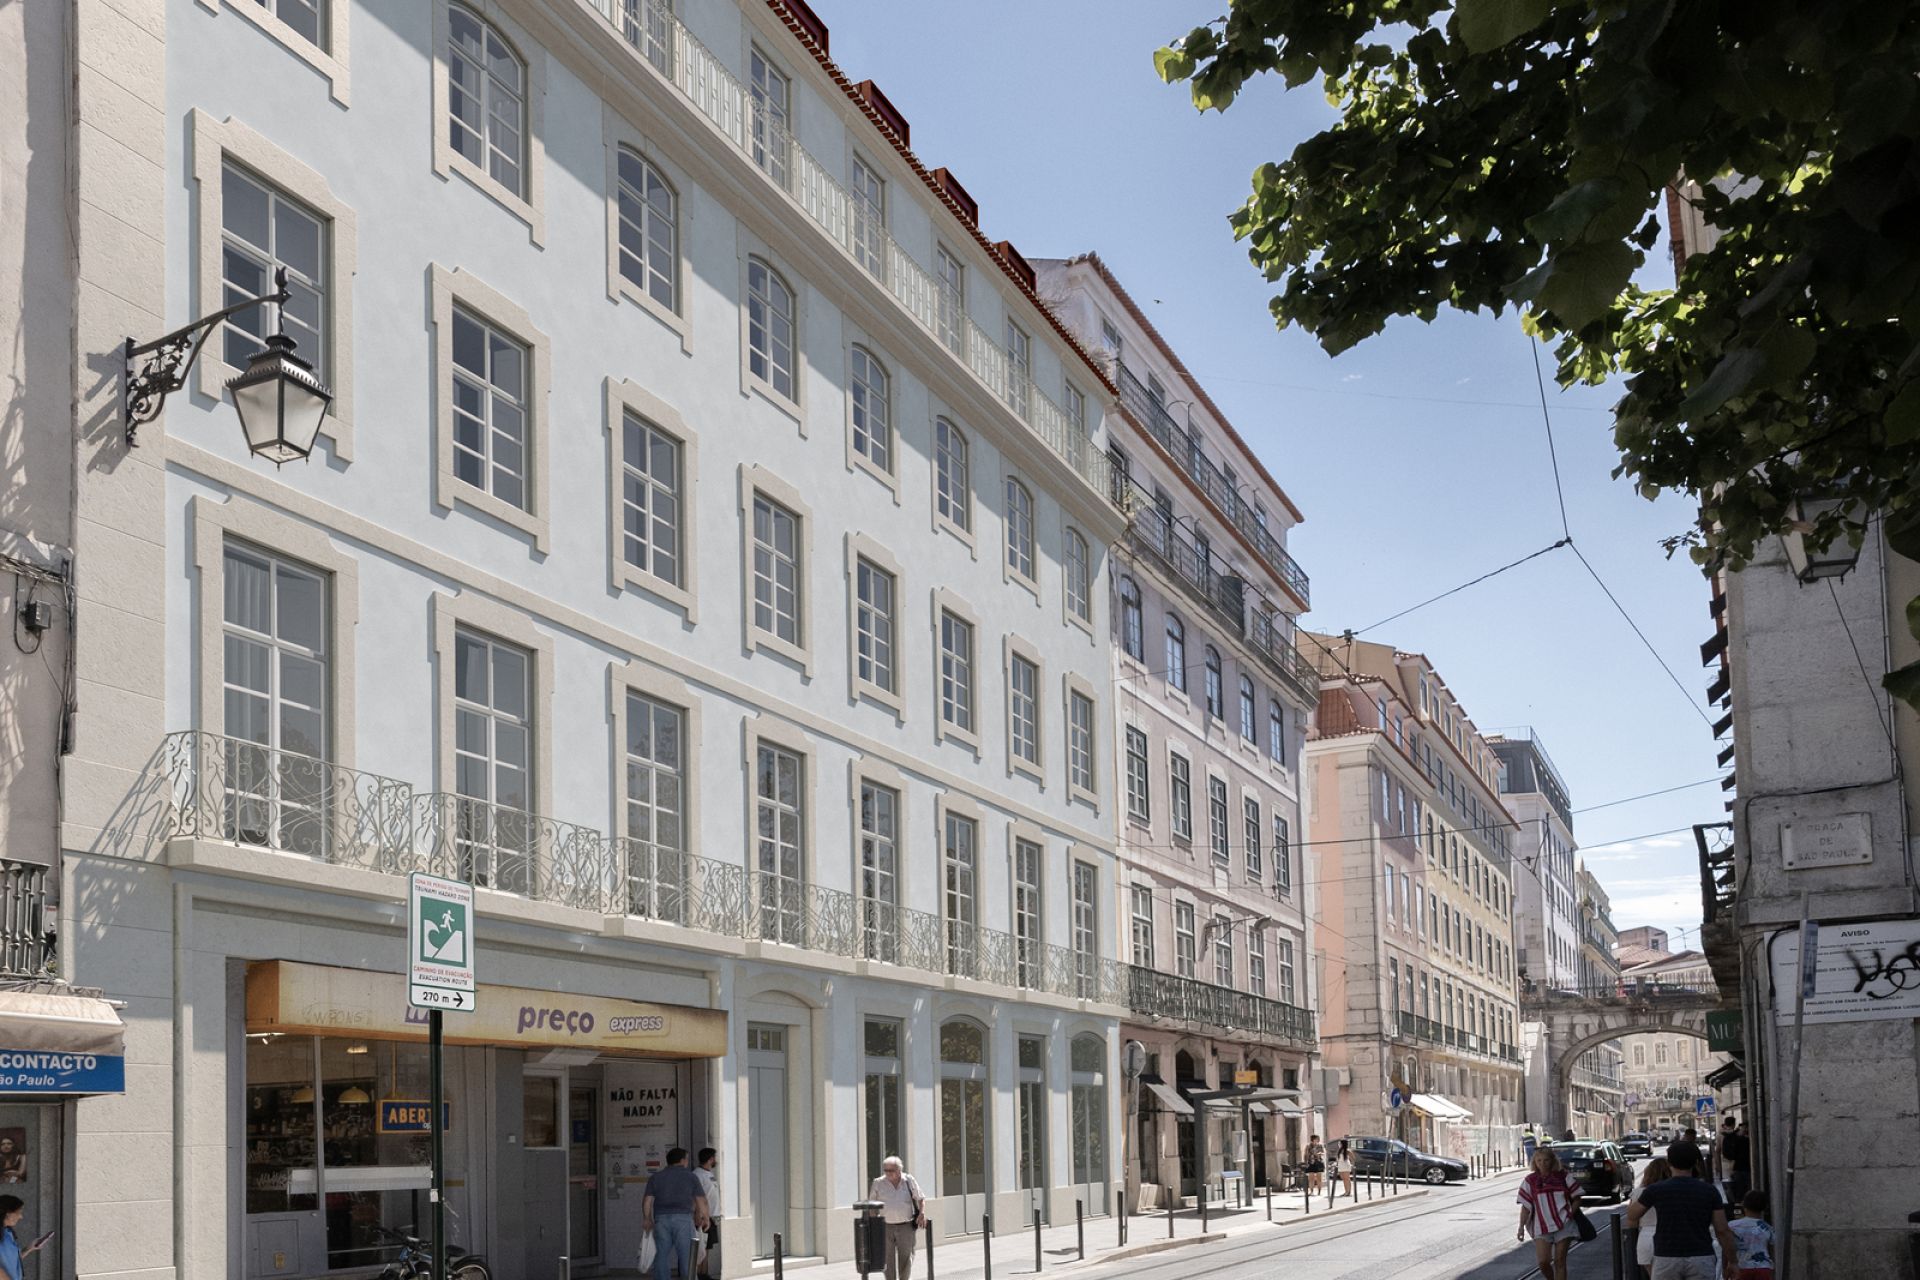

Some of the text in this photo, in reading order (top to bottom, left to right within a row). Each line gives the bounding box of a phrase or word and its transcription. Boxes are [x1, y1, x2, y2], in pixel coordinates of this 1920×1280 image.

[1820, 837, 1834, 846] DE
[1841, 929, 1870, 938] AVISO
[423, 991, 439, 1002] 270
[517, 1006, 663, 1036] preço express
[0, 1054, 97, 1070] CONTACTO
[17, 1074, 55, 1086] Paulo
[611, 1087, 677, 1101] NÃO FALTA
[388, 1107, 432, 1124] ABERT
[623, 1105, 664, 1117] NADA?
